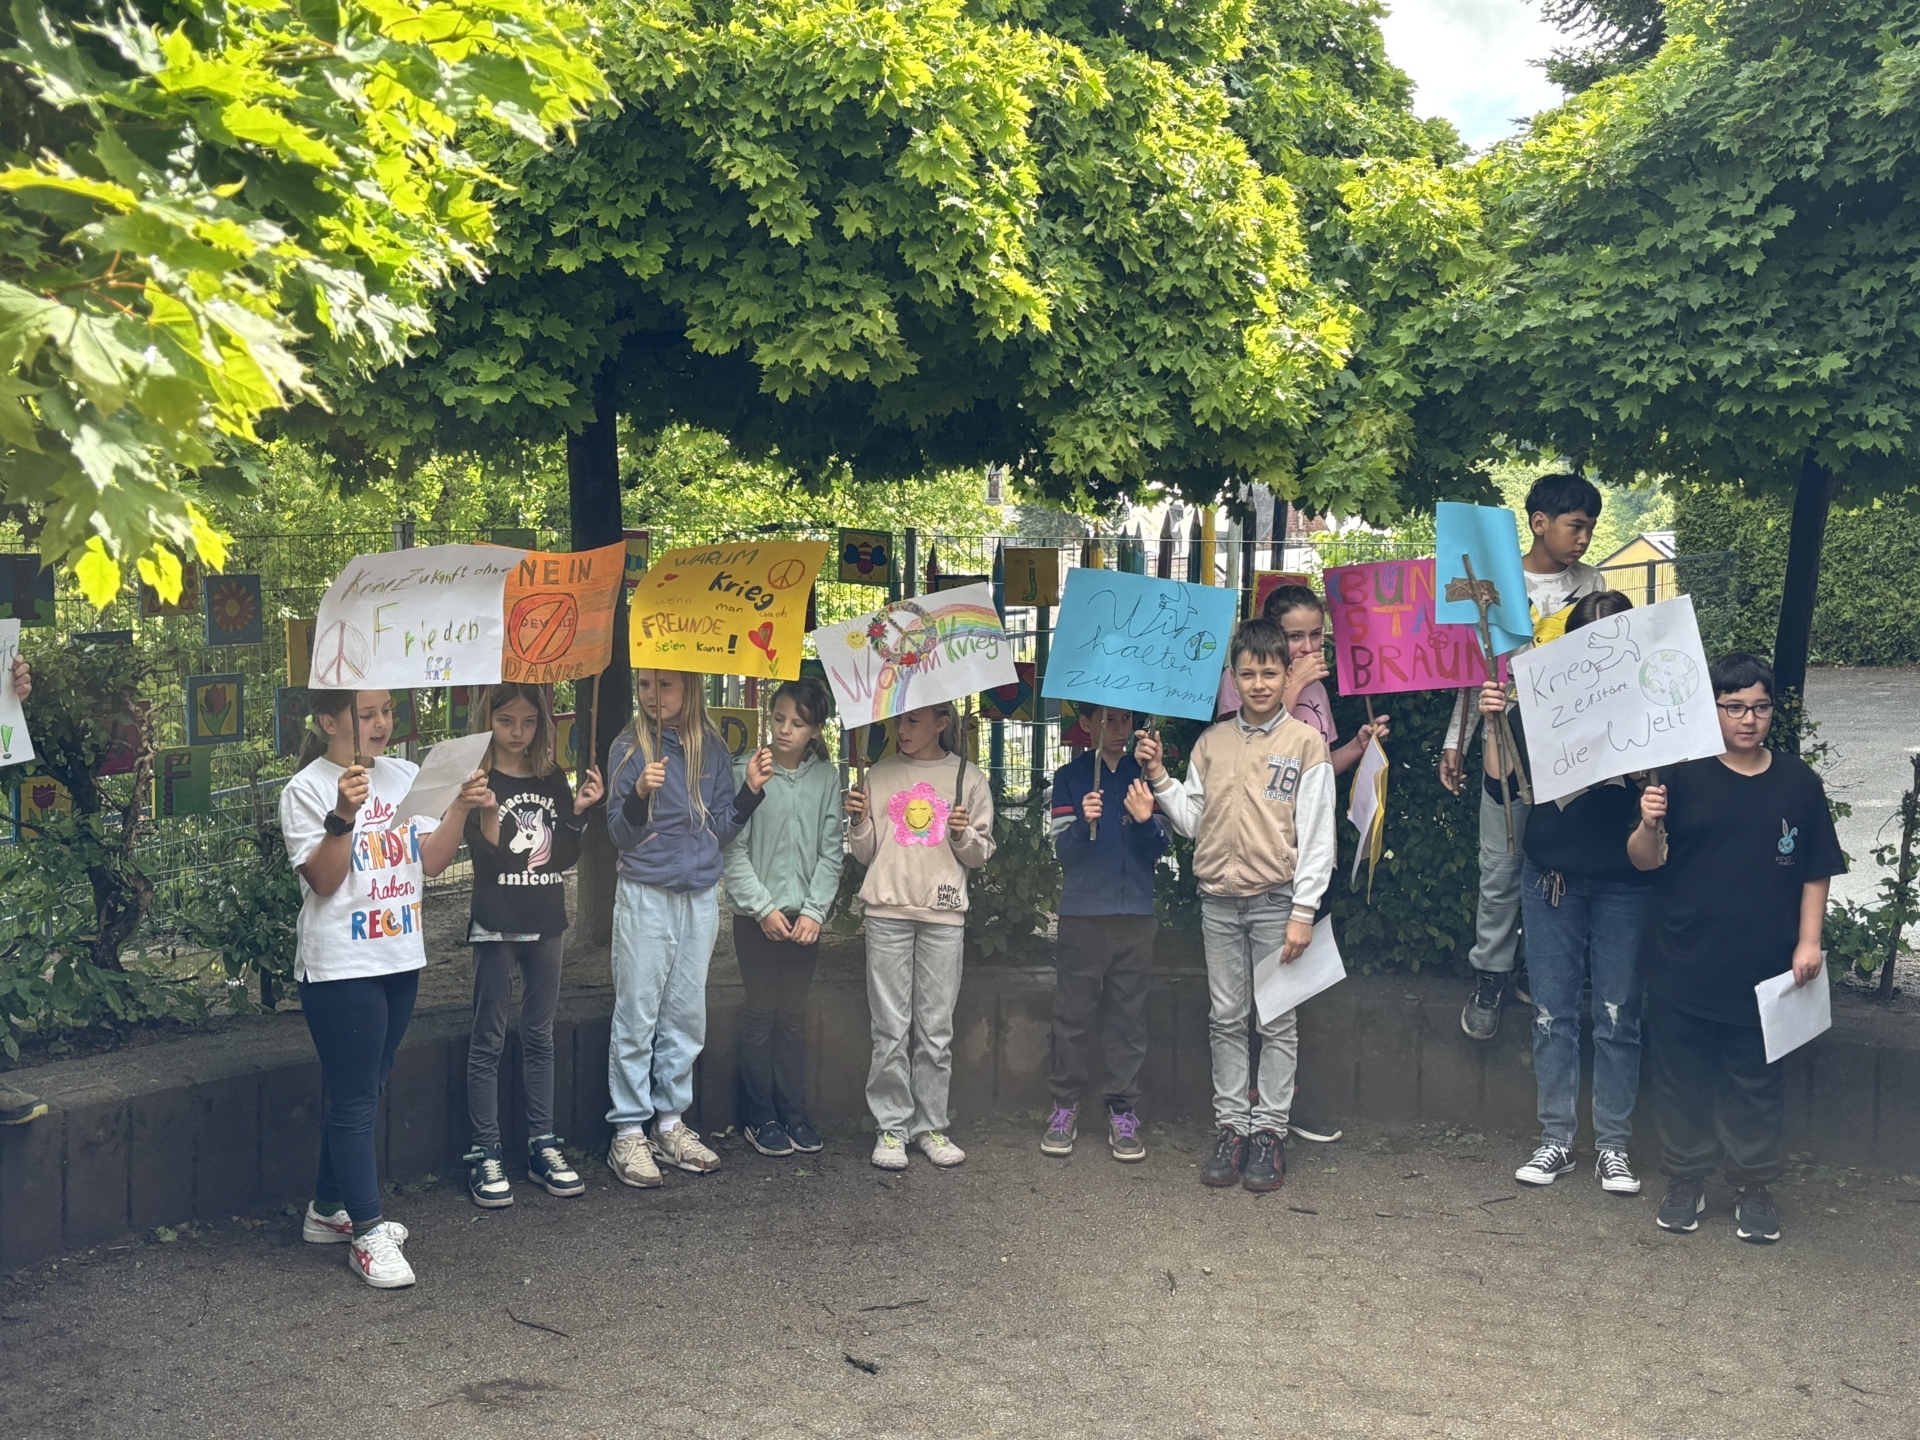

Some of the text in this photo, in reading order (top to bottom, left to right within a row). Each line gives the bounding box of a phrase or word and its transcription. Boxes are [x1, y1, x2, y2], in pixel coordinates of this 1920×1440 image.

[519, 558, 592, 587] NEIN
[675, 548, 759, 567] WARUM
[708, 571, 775, 611] Krieg
[1340, 565, 1434, 606] BUN
[642, 612, 725, 639] FREUNDE
[715, 602, 743, 614] man
[1087, 590, 1191, 639] Wir
[1347, 603, 1475, 643] STA
[373, 601, 479, 657] Frieden
[938, 615, 998, 663] Krieg
[504, 657, 583, 682] DANKE
[1077, 625, 1193, 676] halten
[1529, 659, 1600, 707] Krieg
[1554, 706, 1686, 775] die Welt
[1267, 763, 1298, 794] 78
[367, 874, 415, 900] haben
